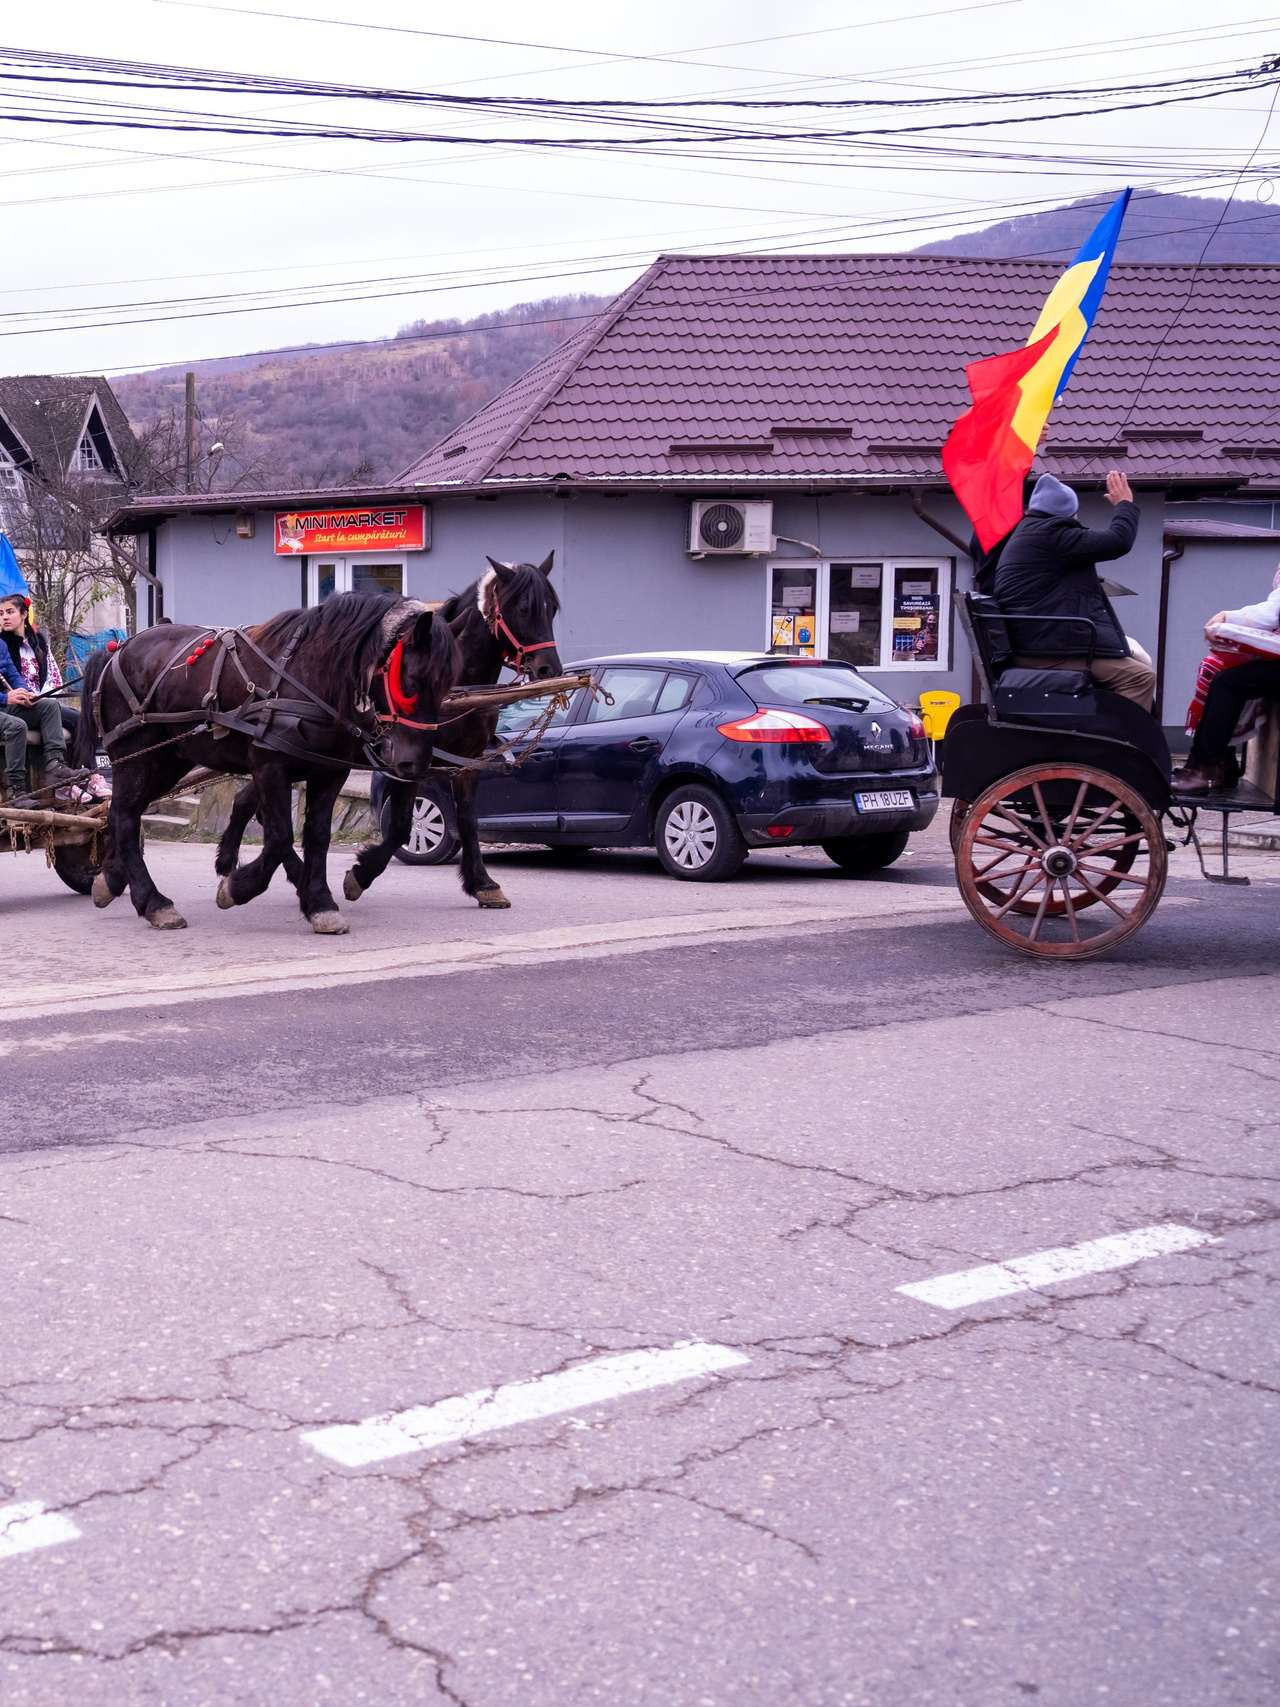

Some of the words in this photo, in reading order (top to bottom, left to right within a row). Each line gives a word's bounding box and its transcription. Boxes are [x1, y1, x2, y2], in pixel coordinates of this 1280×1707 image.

[295, 515, 327, 530] MINI
[331, 511, 407, 528] MARKET
[336, 531, 347, 542] la
[348, 529, 407, 545] cumpărături!
[861, 794, 878, 808] PH
